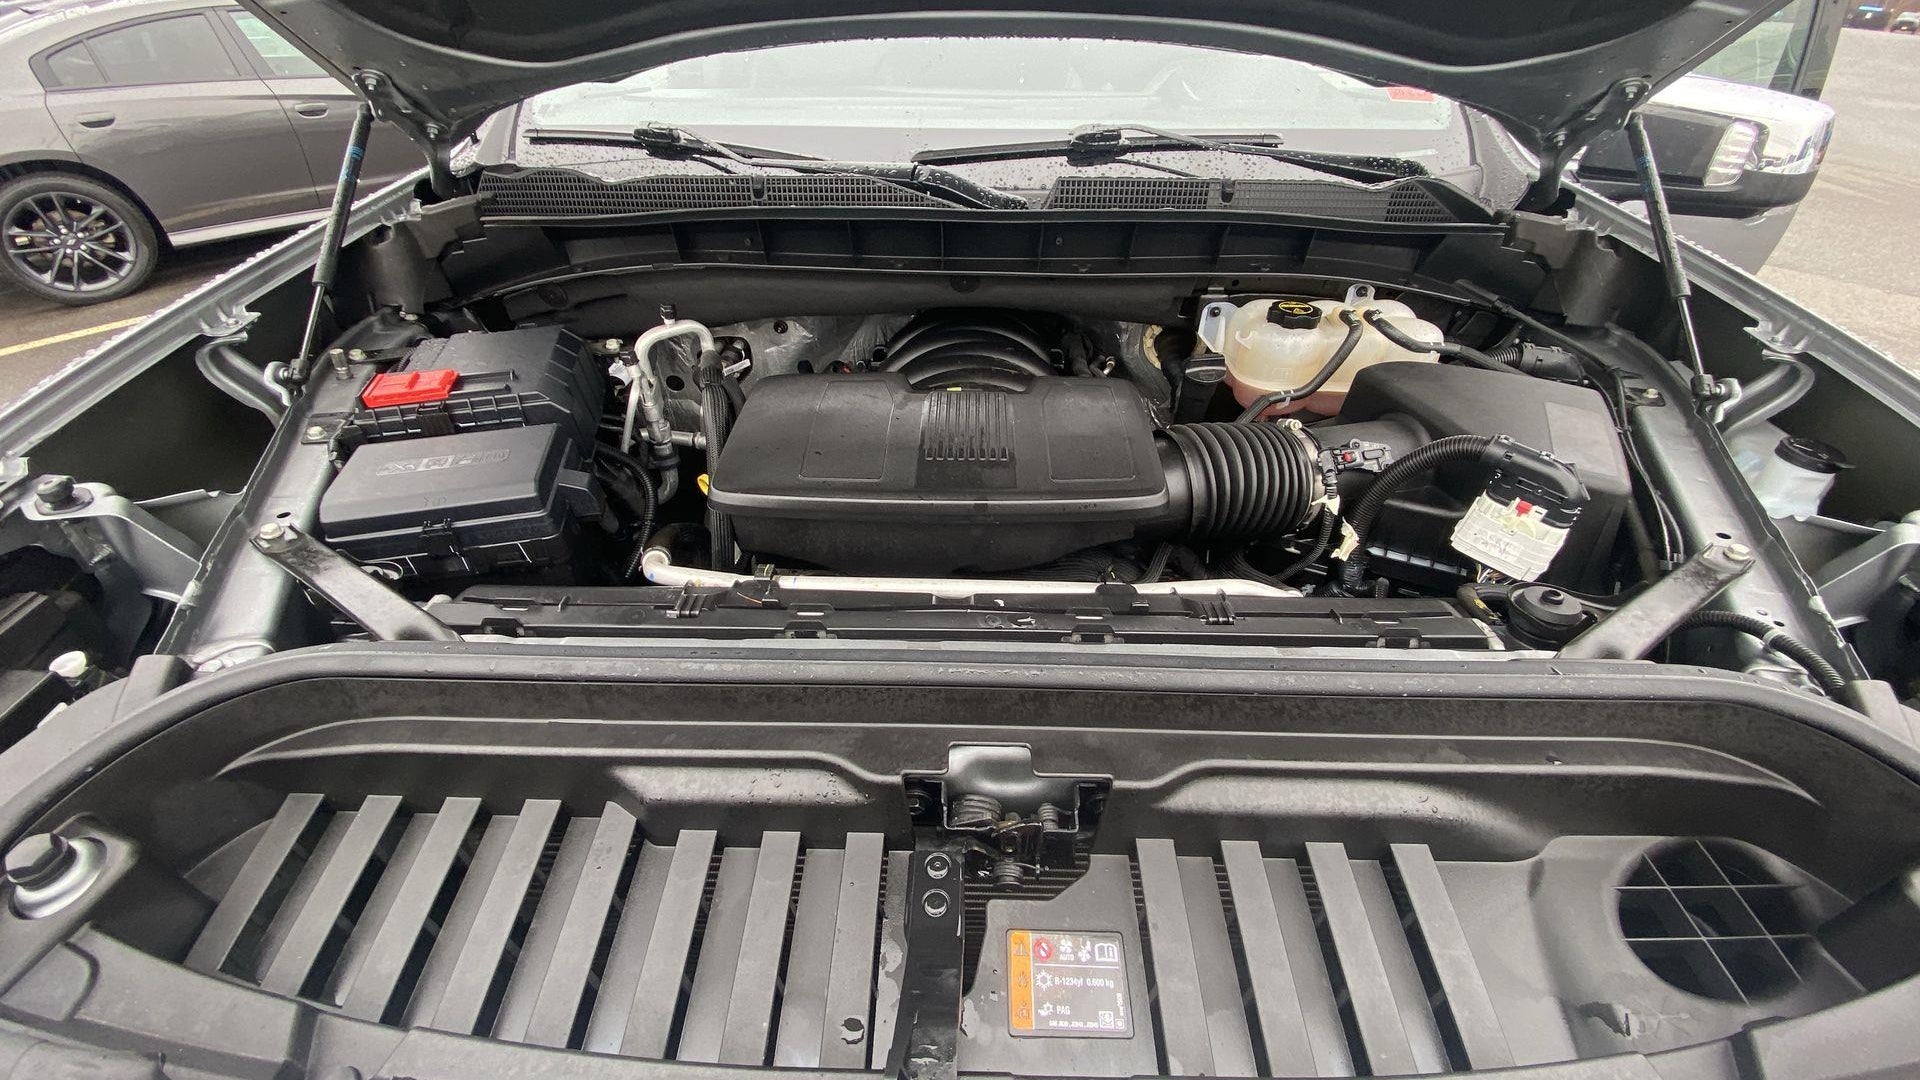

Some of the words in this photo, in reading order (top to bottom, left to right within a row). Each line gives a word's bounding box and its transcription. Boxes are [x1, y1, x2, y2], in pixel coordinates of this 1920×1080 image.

[1054, 976, 1084, 987] R-1234yf
[1105, 979, 1114, 988] kg
[1056, 1005, 1071, 1015] PAG
